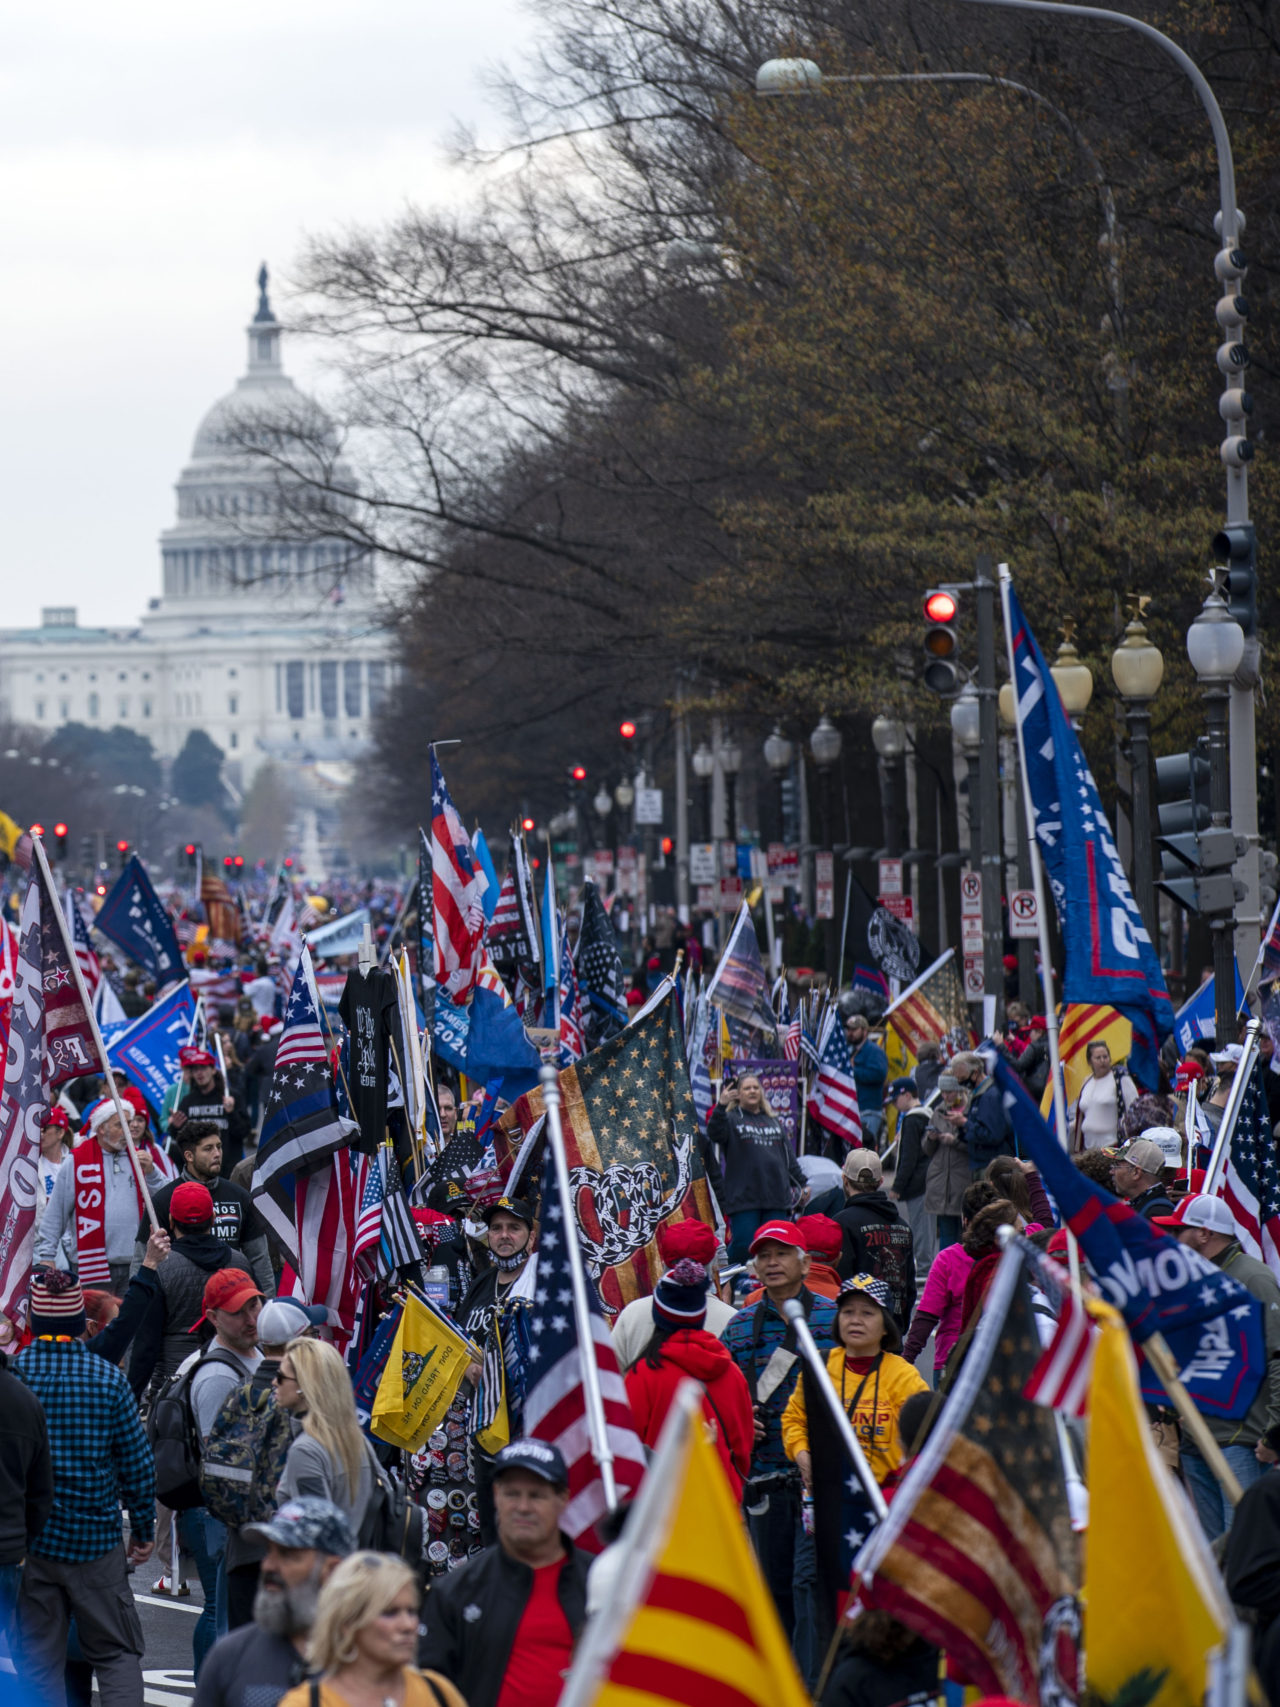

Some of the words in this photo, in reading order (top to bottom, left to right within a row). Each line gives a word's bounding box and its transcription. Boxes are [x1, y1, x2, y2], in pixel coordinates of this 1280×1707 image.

[440, 1006, 469, 1036] AMER
[127, 1046, 151, 1067] KEEP
[76, 1163, 102, 1239] USA
